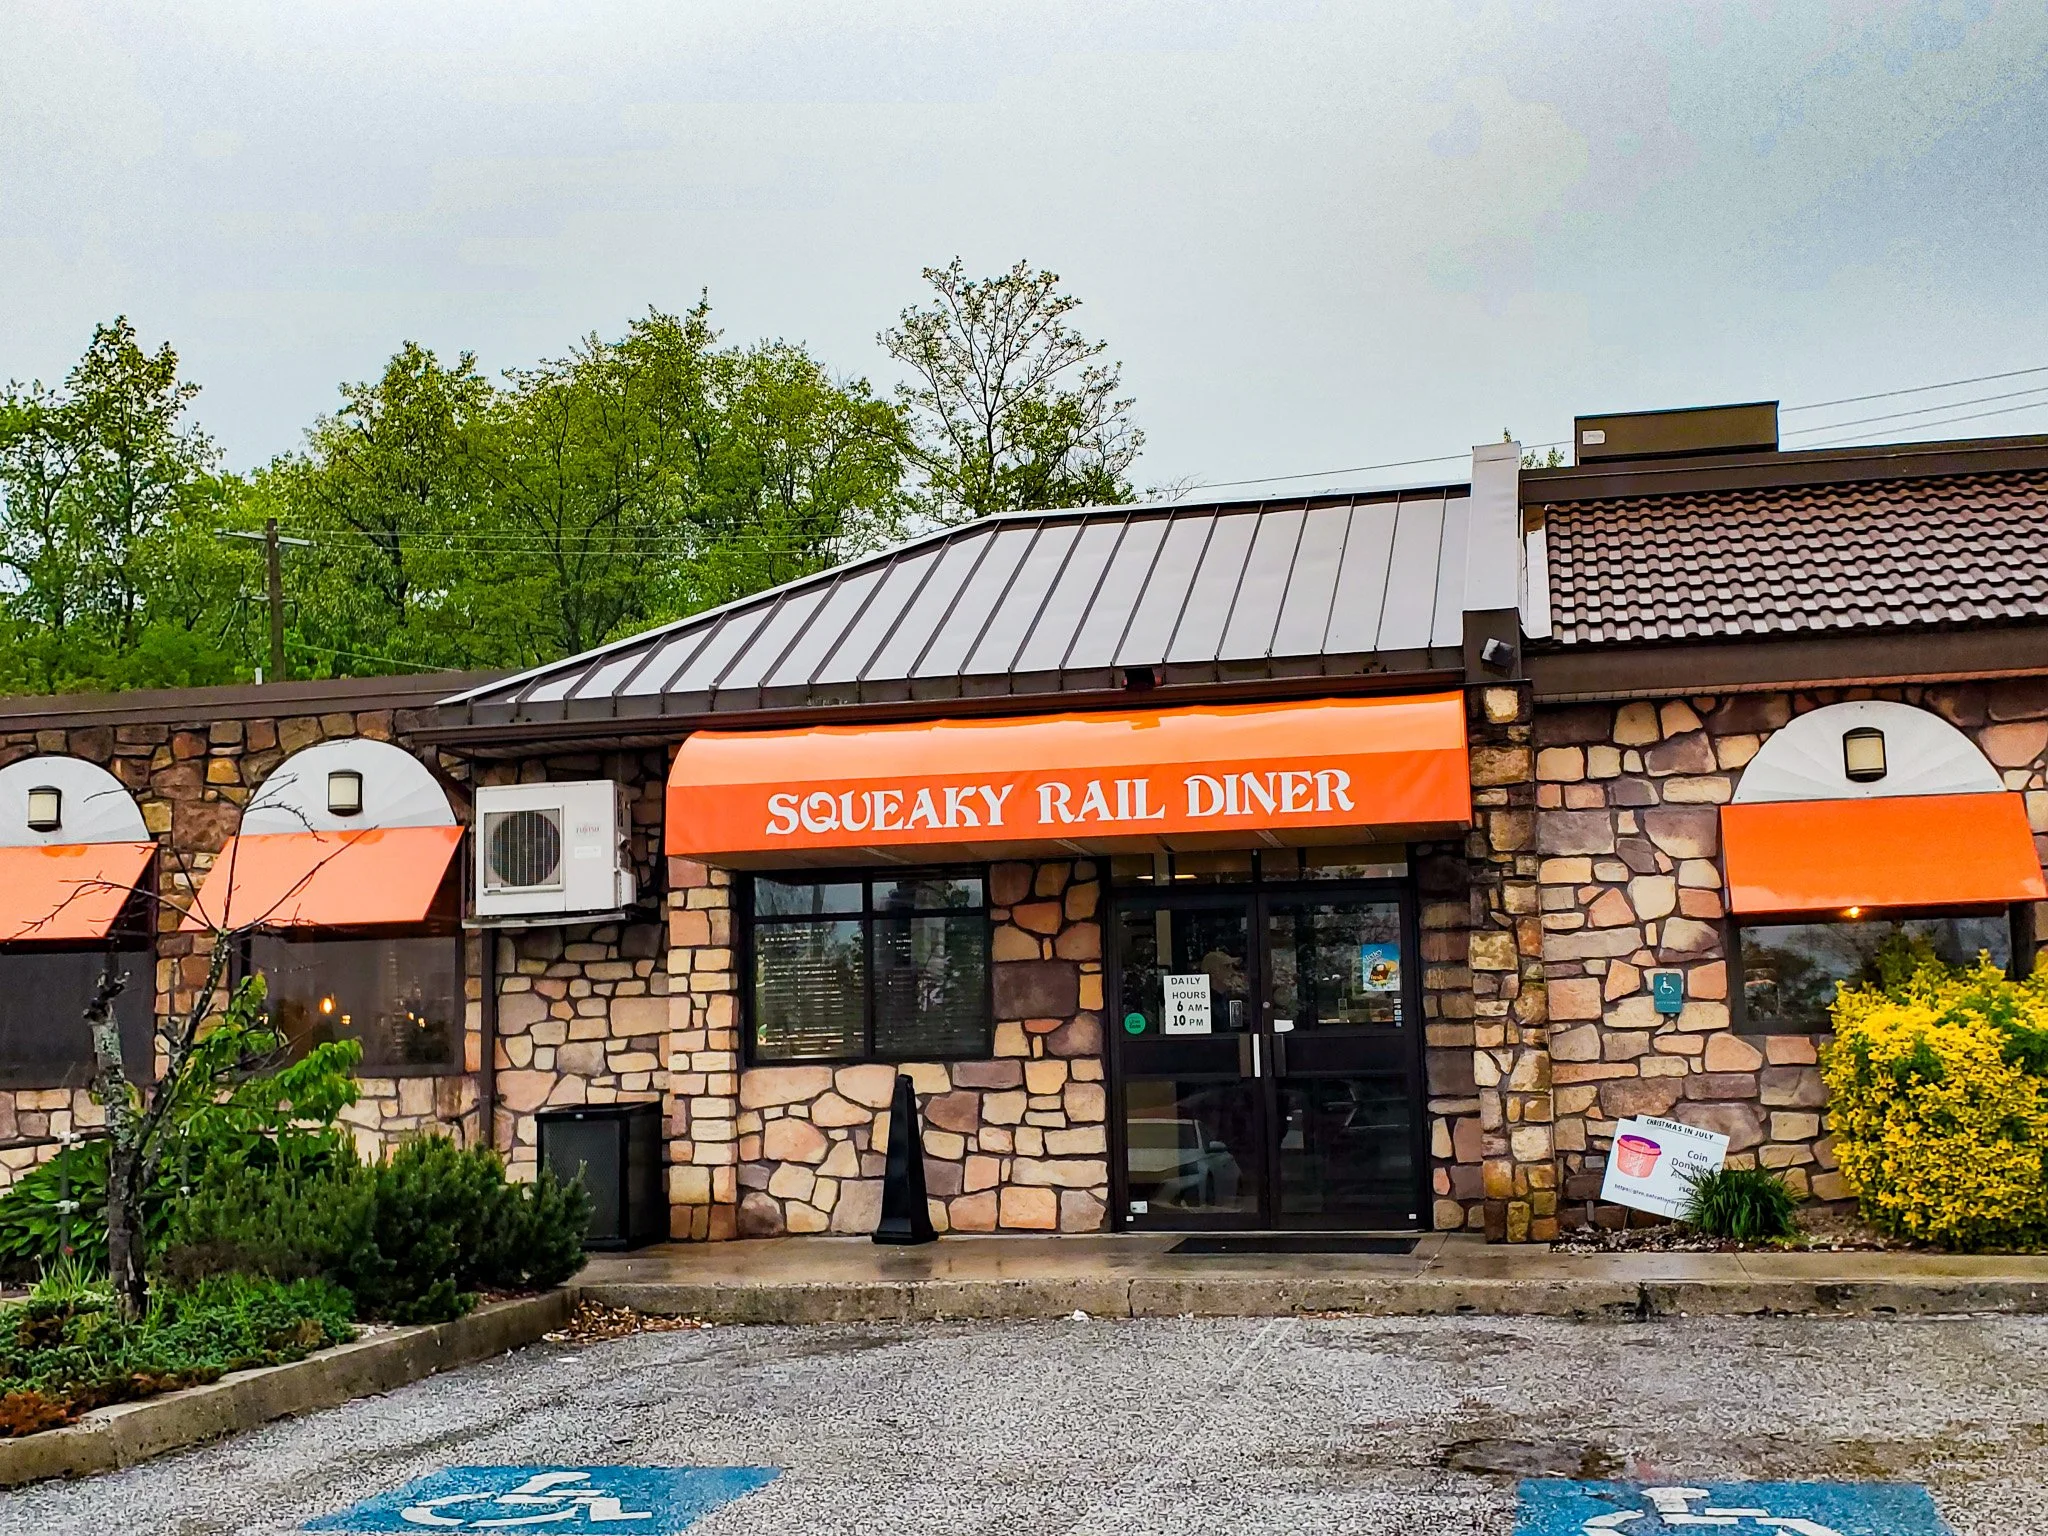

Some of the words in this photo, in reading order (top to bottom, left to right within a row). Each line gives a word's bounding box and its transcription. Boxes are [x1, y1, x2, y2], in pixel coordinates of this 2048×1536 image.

[765, 784, 1014, 835] SQUEAKY
[1036, 779, 1166, 824] RAIL
[1183, 769, 1355, 817] DINER
[1171, 977, 1201, 985] DAILY
[1172, 991, 1207, 1000] HOURS
[1177, 1000, 1184, 1012] 6
[1173, 1015, 1186, 1027] 10
[1189, 1018, 1204, 1027] PM
[1646, 1118, 1682, 1132] CHRISTMAS
[1684, 1127, 1693, 1135] IN
[1694, 1130, 1714, 1141] JULY
[1687, 1150, 1708, 1163] Coin
